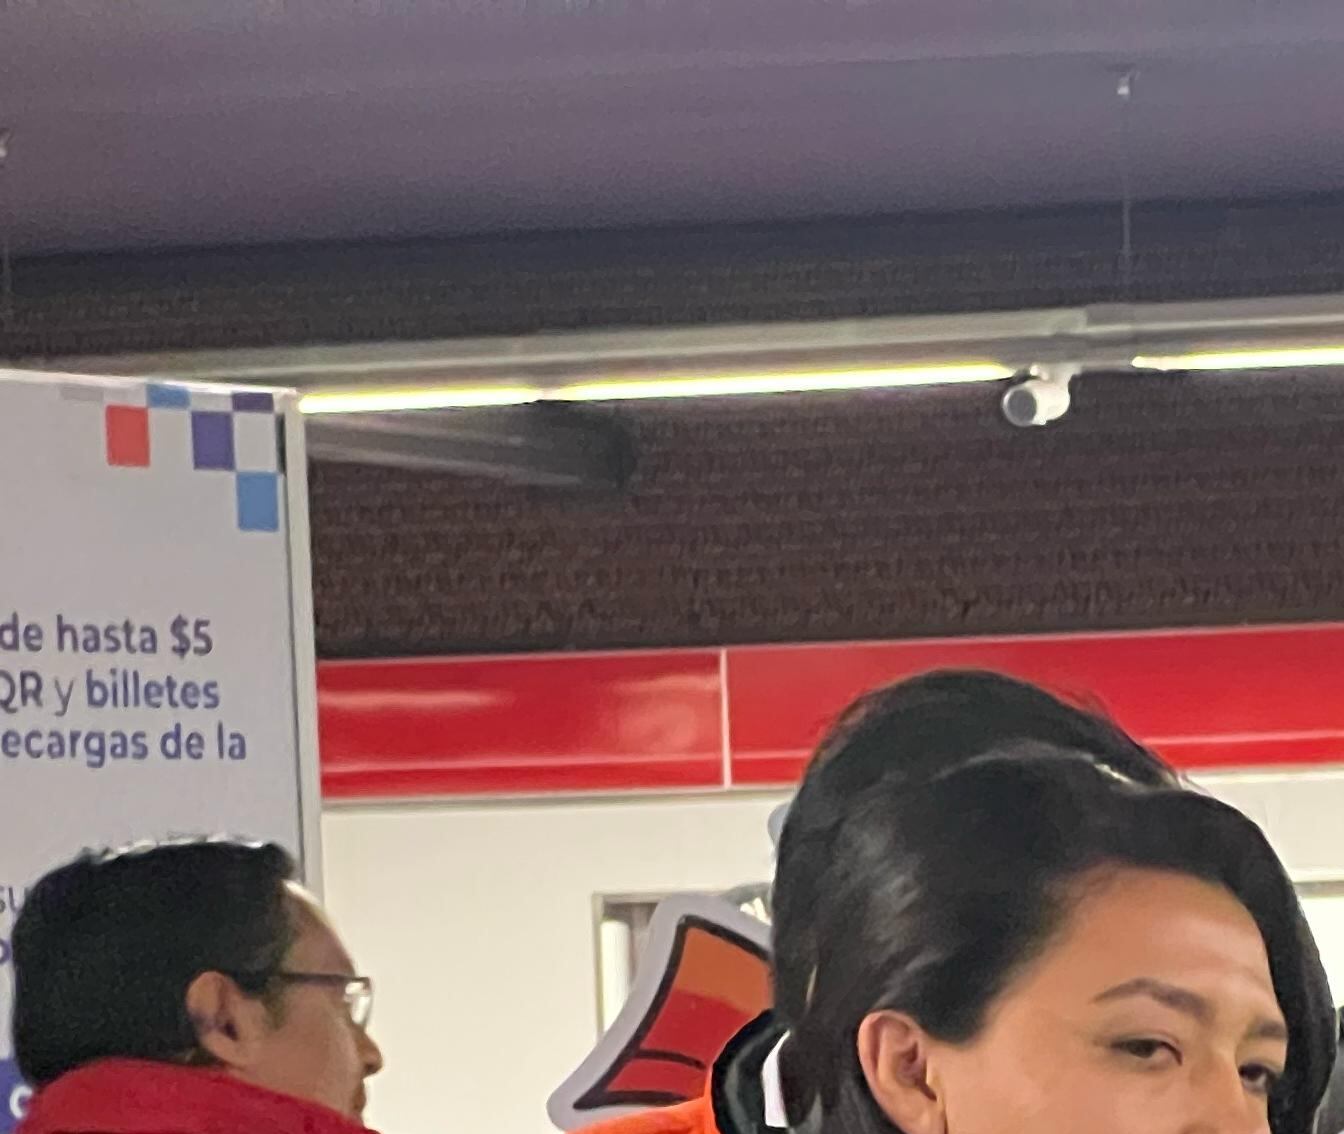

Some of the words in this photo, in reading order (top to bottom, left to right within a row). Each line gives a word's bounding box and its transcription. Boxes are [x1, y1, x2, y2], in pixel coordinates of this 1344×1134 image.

[0, 611, 43, 651] de
[57, 613, 158, 654] hasta
[170, 614, 213, 659] $5
[54, 679, 75, 716] y
[86, 668, 220, 709] billetes
[1, 729, 148, 768] ecargas
[160, 722, 205, 759] de
[217, 720, 247, 760] la
